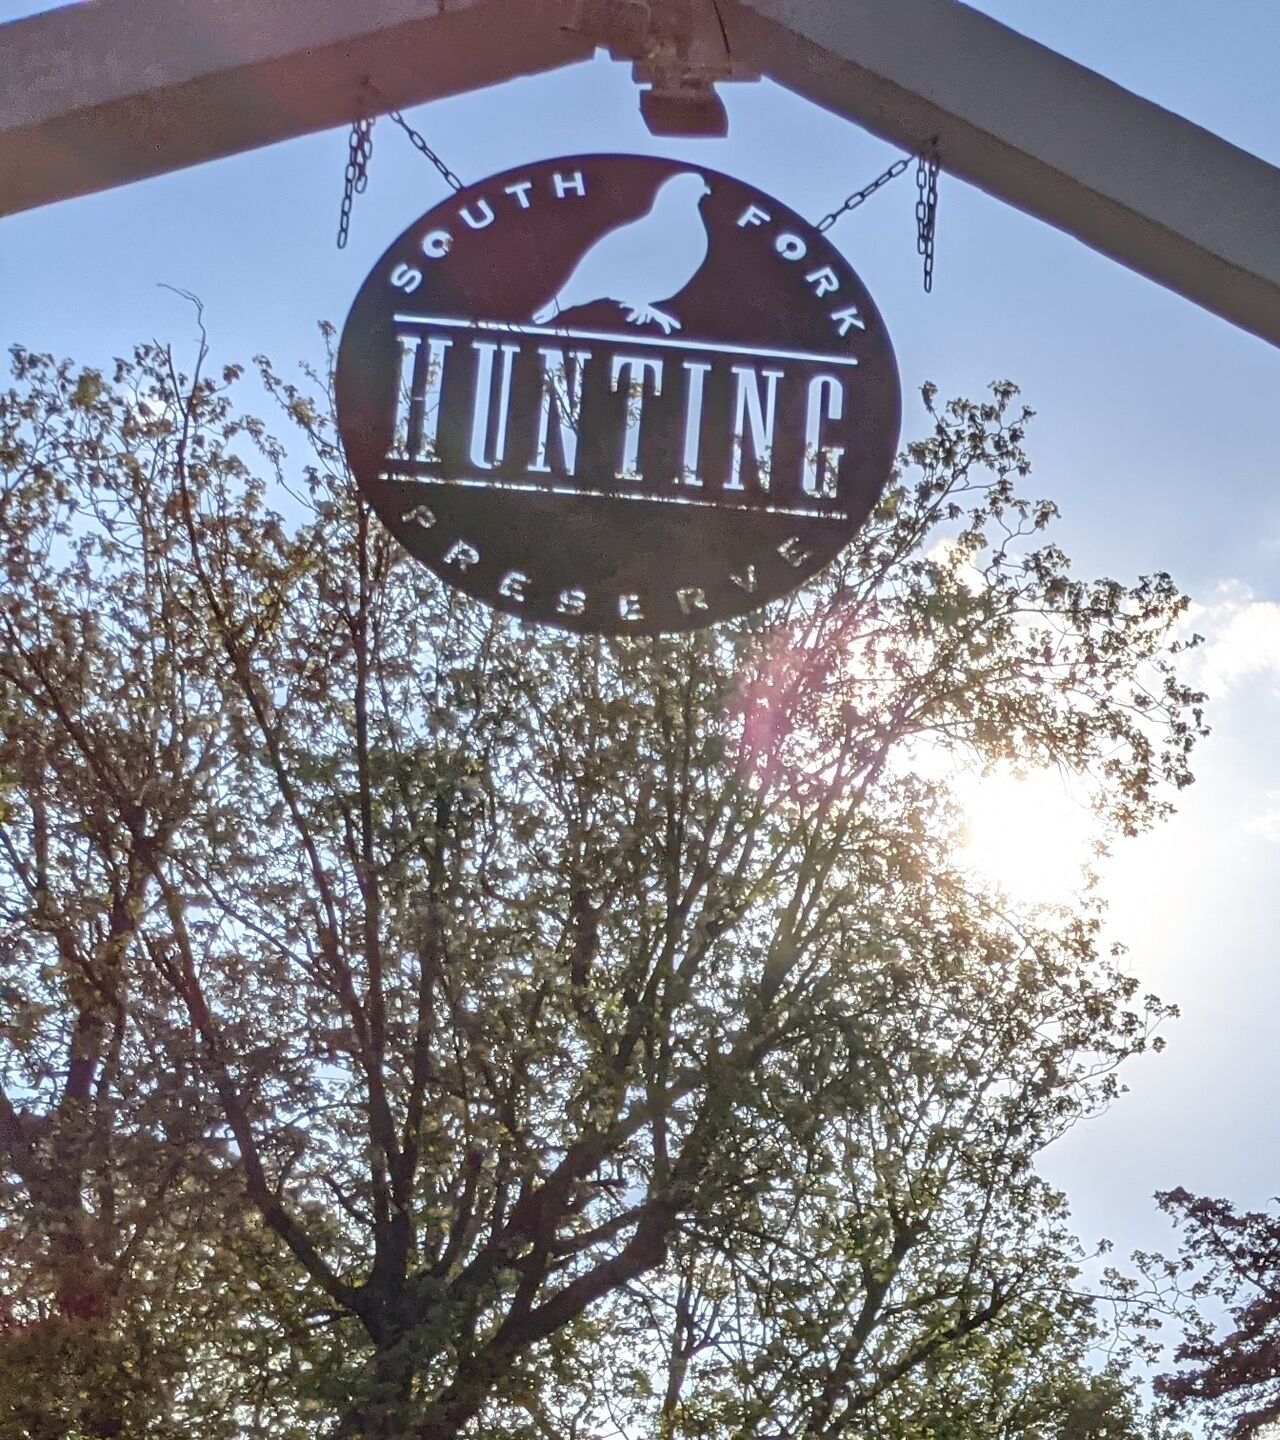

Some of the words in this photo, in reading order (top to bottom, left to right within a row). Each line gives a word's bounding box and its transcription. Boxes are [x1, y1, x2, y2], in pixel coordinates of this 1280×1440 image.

[390, 171, 587, 294] SOUTH
[737, 205, 866, 337] FORK
[385, 334, 846, 499] HUNTING
[401, 503, 816, 622] PRESERVE
